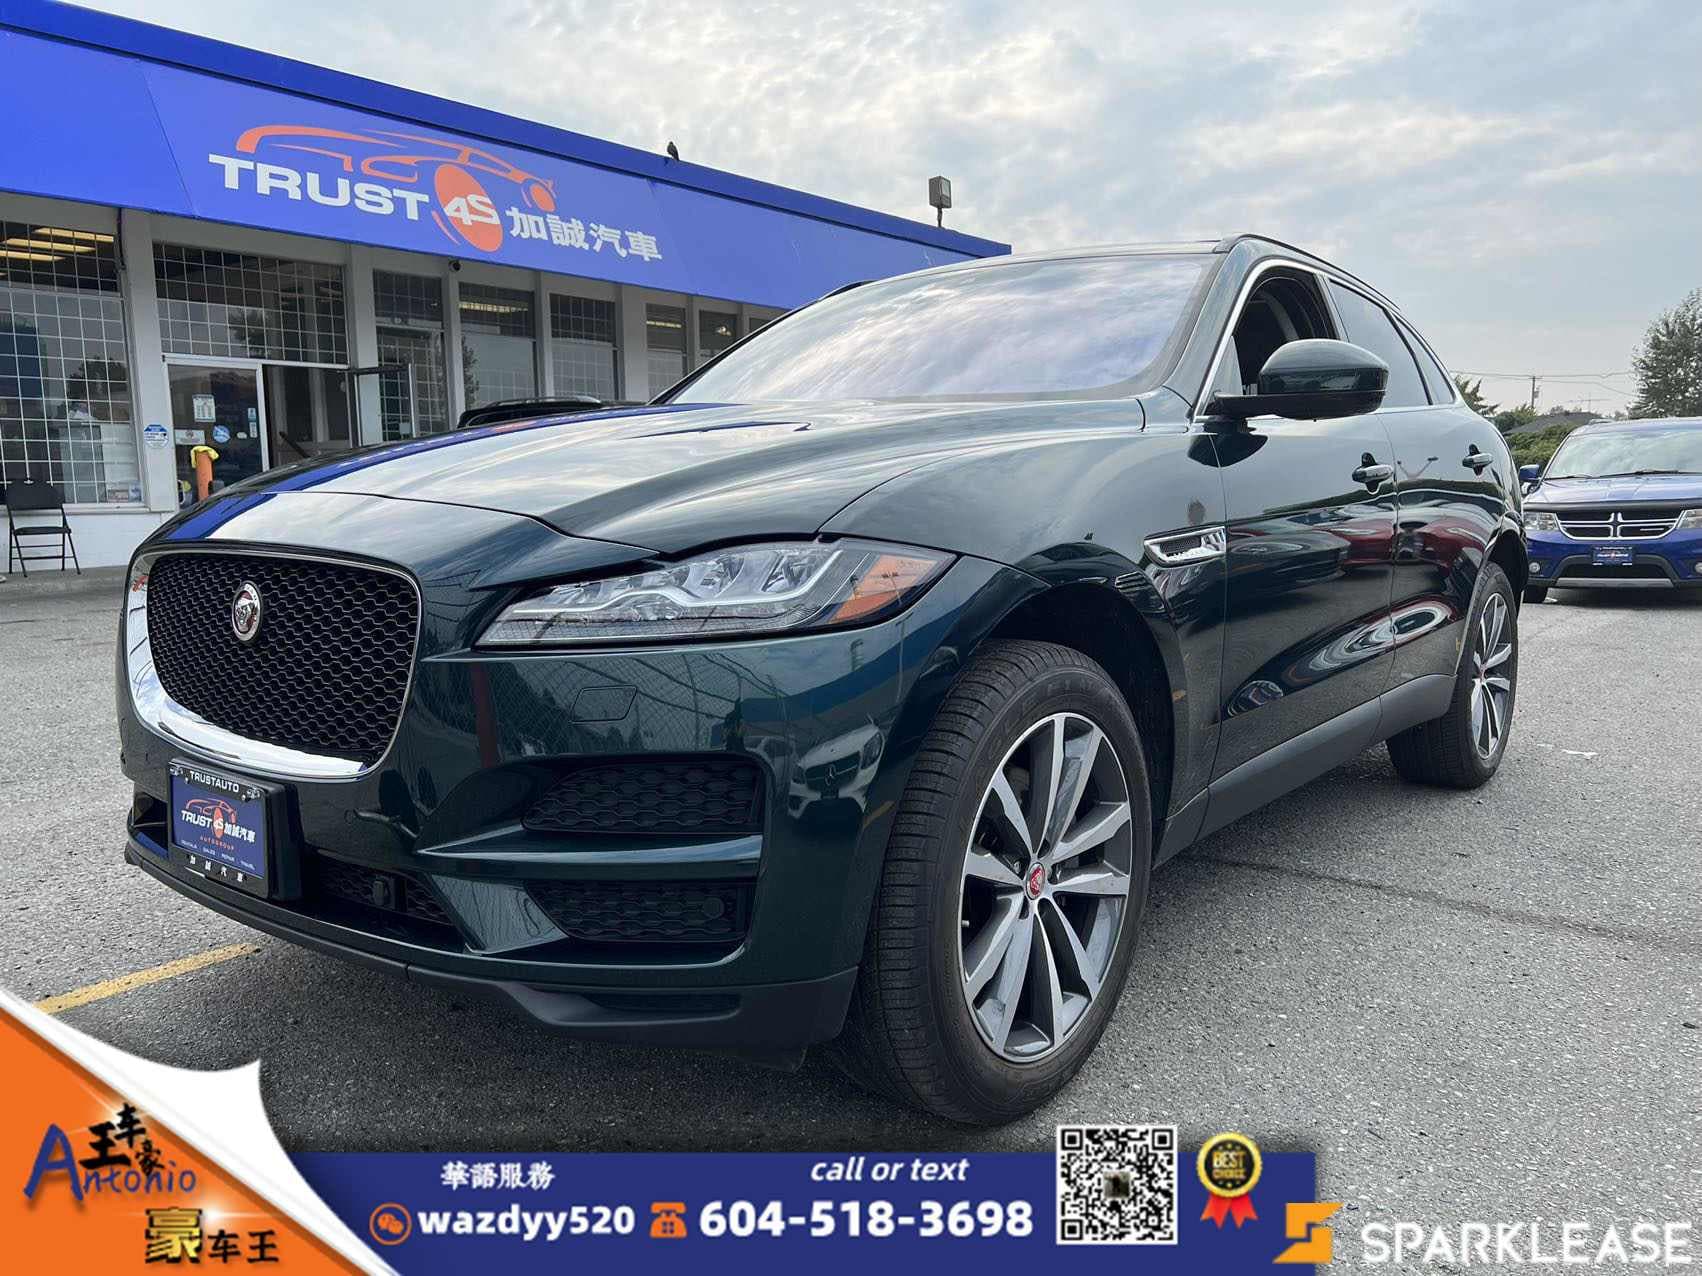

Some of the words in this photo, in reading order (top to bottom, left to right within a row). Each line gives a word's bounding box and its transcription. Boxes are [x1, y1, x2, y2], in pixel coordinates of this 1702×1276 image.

[208, 153, 429, 221] TRUST
[443, 194, 500, 226] 4S
[506, 207, 663, 262] 加誠汽車
[190, 770, 240, 793] TRUSTAUTO
[181, 810, 212, 828] TRUST
